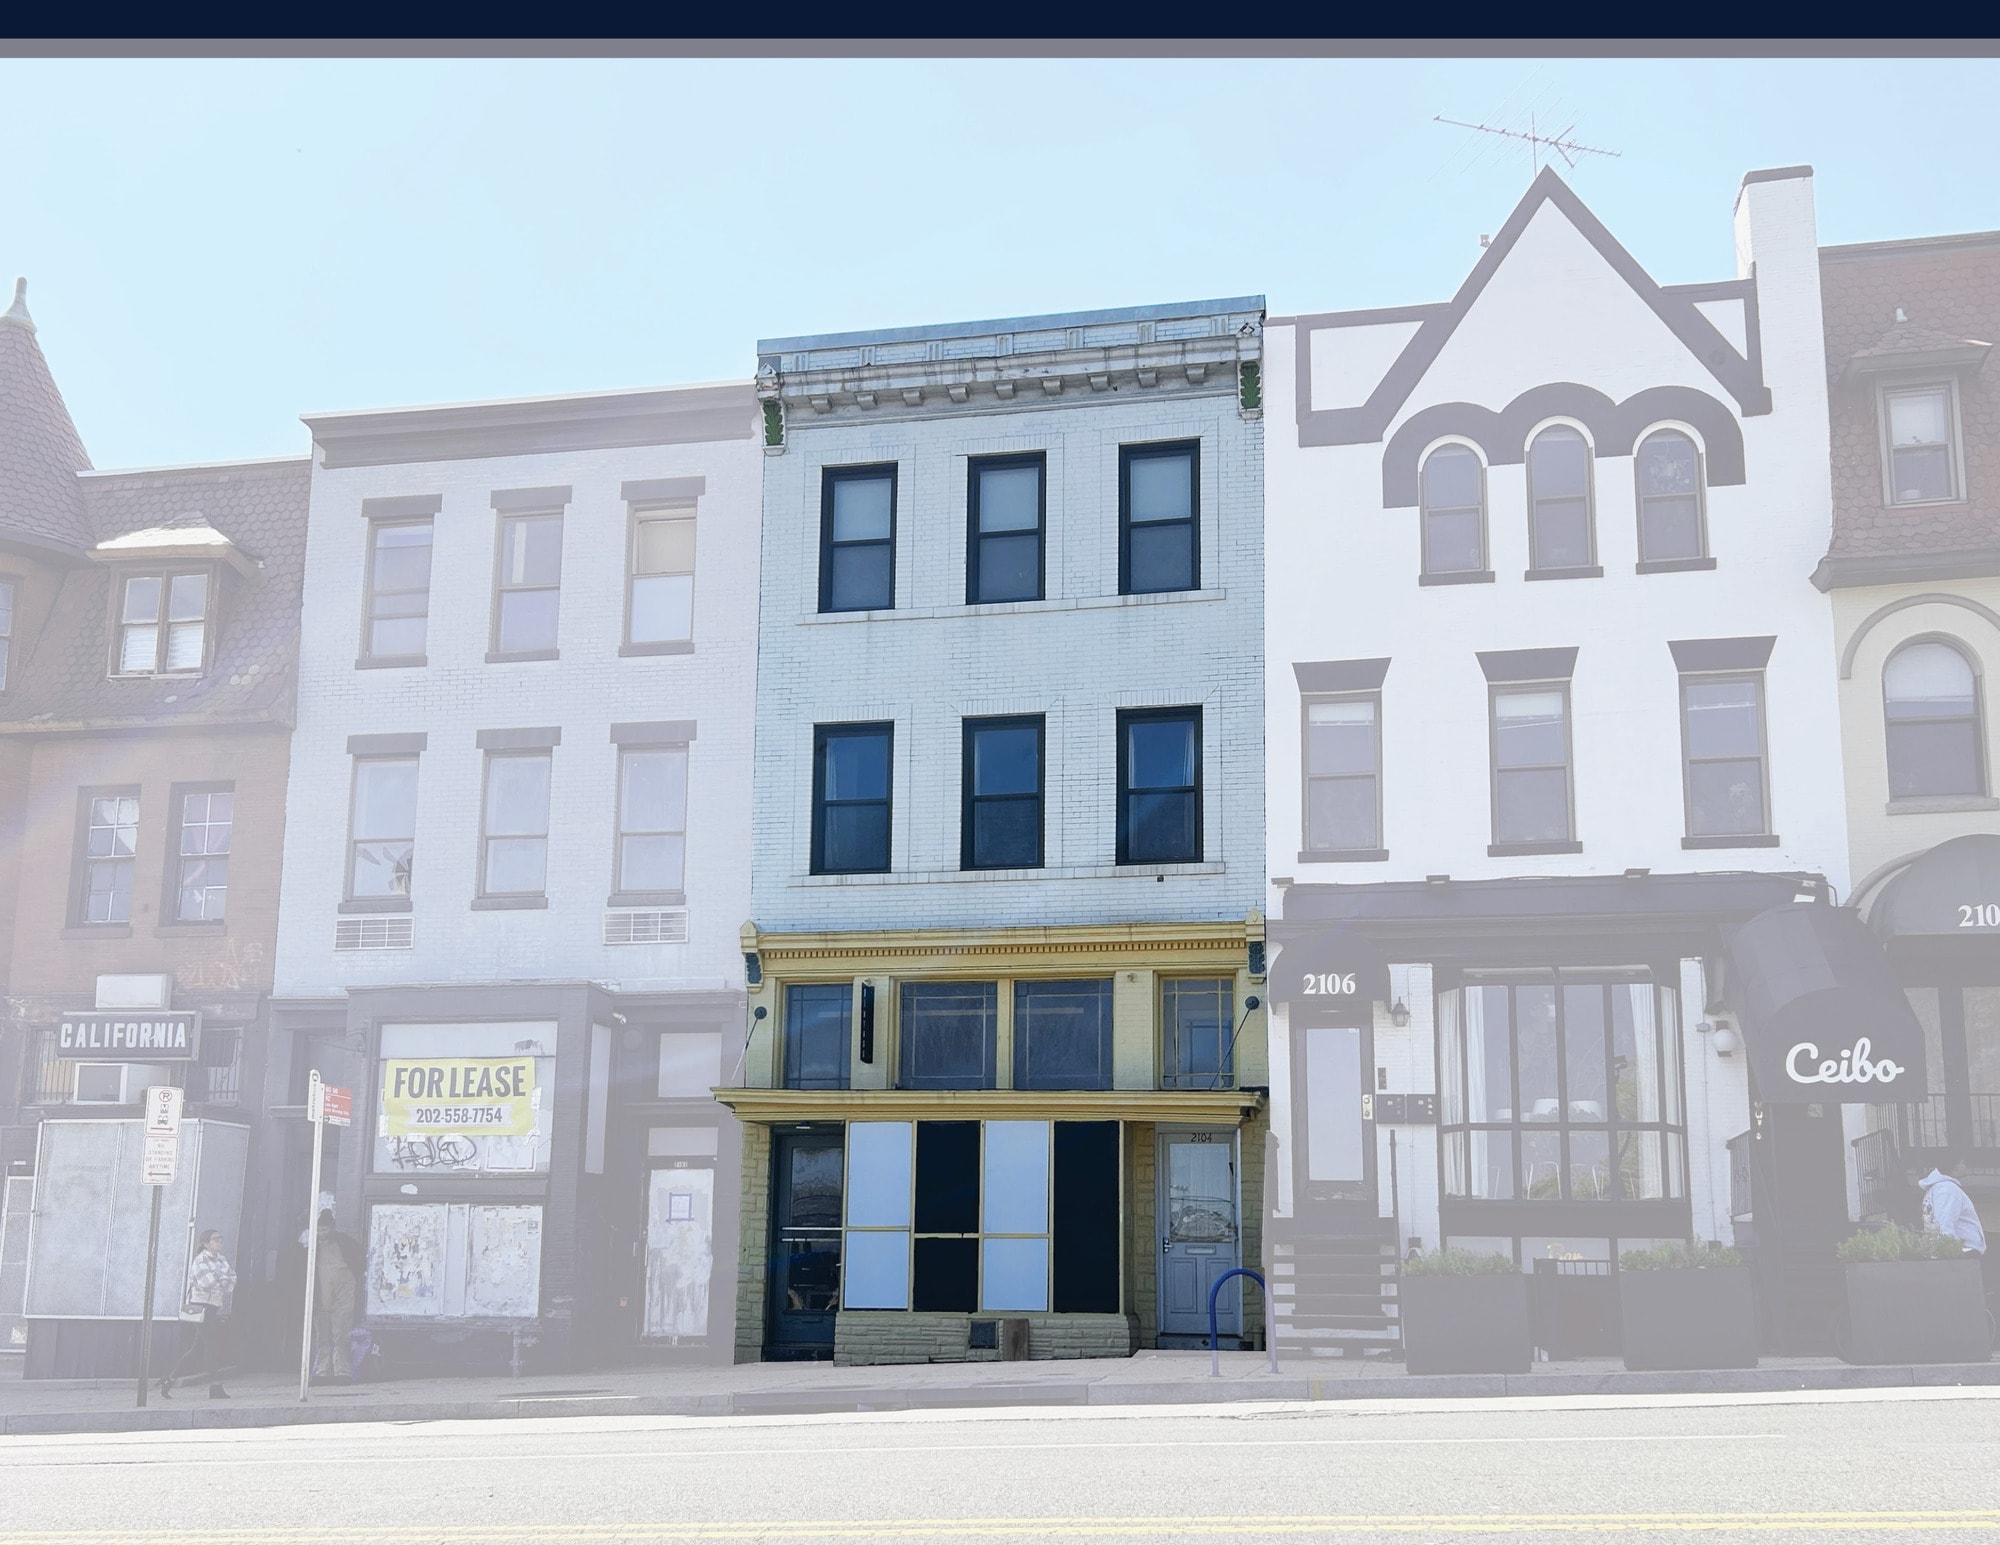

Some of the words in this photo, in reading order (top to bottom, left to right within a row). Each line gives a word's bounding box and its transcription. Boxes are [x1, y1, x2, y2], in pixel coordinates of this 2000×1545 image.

[1303, 973, 1356, 995] 2106
[60, 1022, 186, 1048] CALIFORNIA
[1786, 1037, 1905, 1084] Ceibo
[394, 1066, 445, 1099] FOR
[449, 1066, 527, 1098] LEASE
[417, 1107, 503, 1124] 202-558-7754
[1191, 1132, 1212, 1143] 2104
